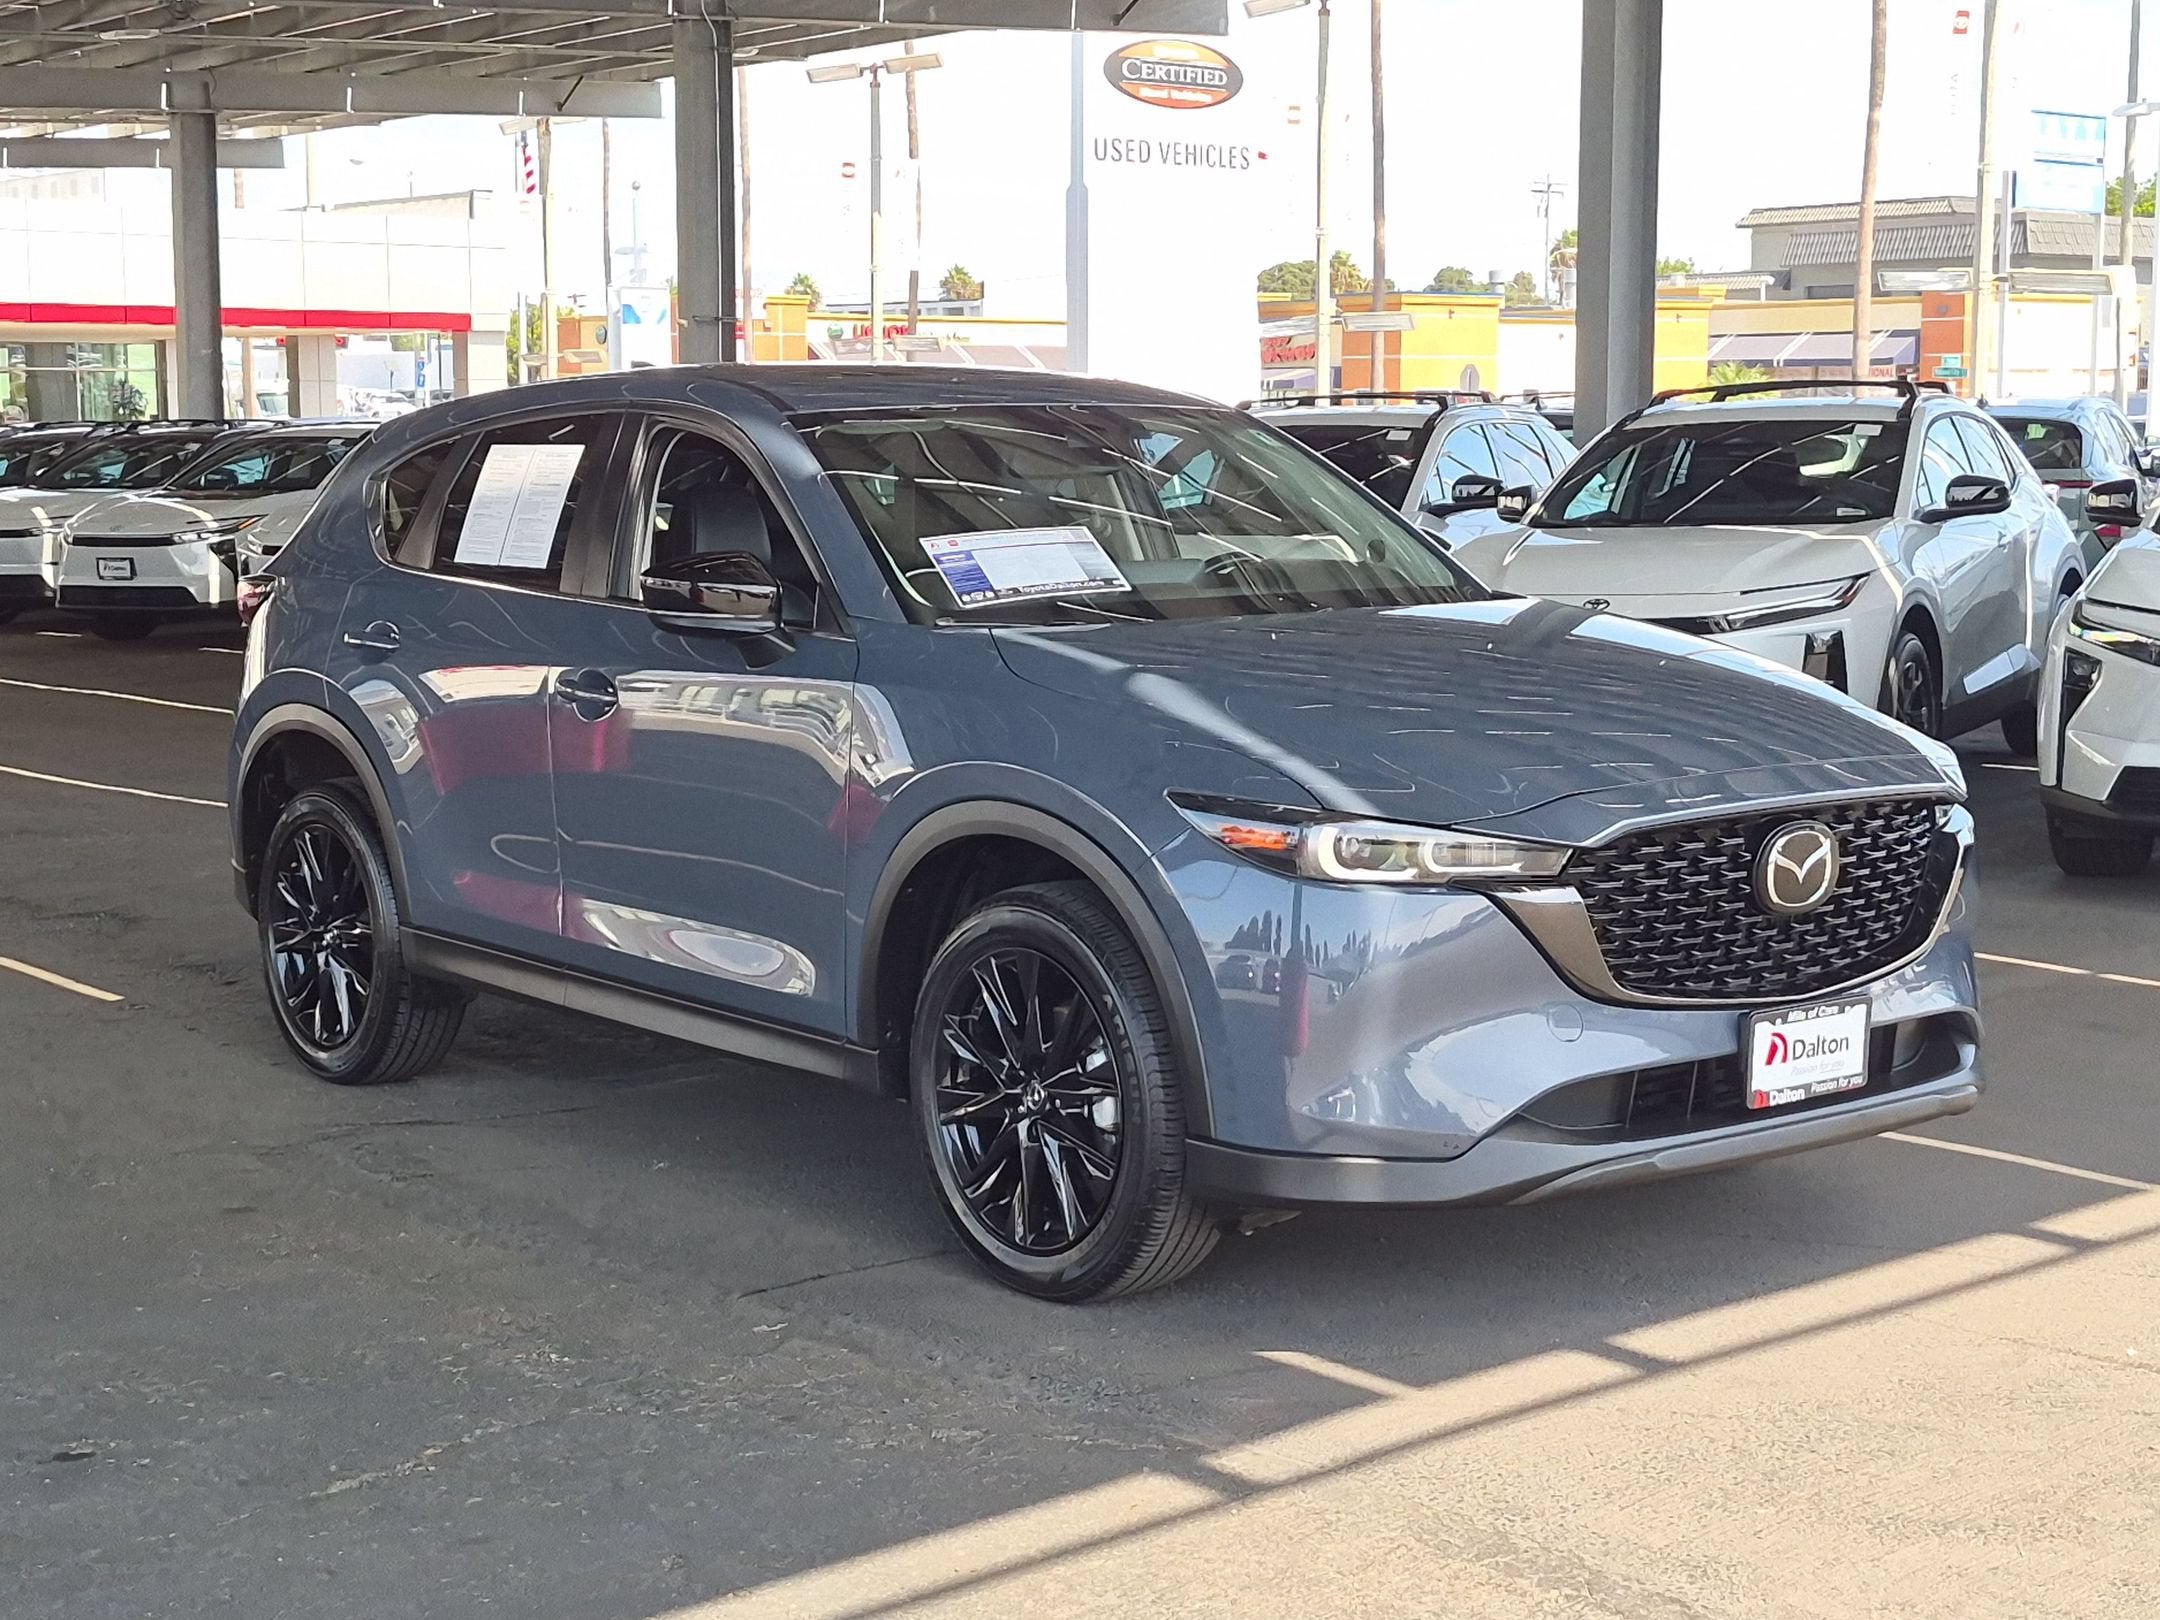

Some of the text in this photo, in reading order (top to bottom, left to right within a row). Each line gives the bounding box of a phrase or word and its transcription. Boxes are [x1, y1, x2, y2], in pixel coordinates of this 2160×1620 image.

[1093, 137, 1251, 170] USED VEHICLES
[1792, 1034, 1849, 1061] Dalton
[1810, 1075, 1863, 1094] Passion for you
[1769, 1087, 1806, 1107] Dalton
